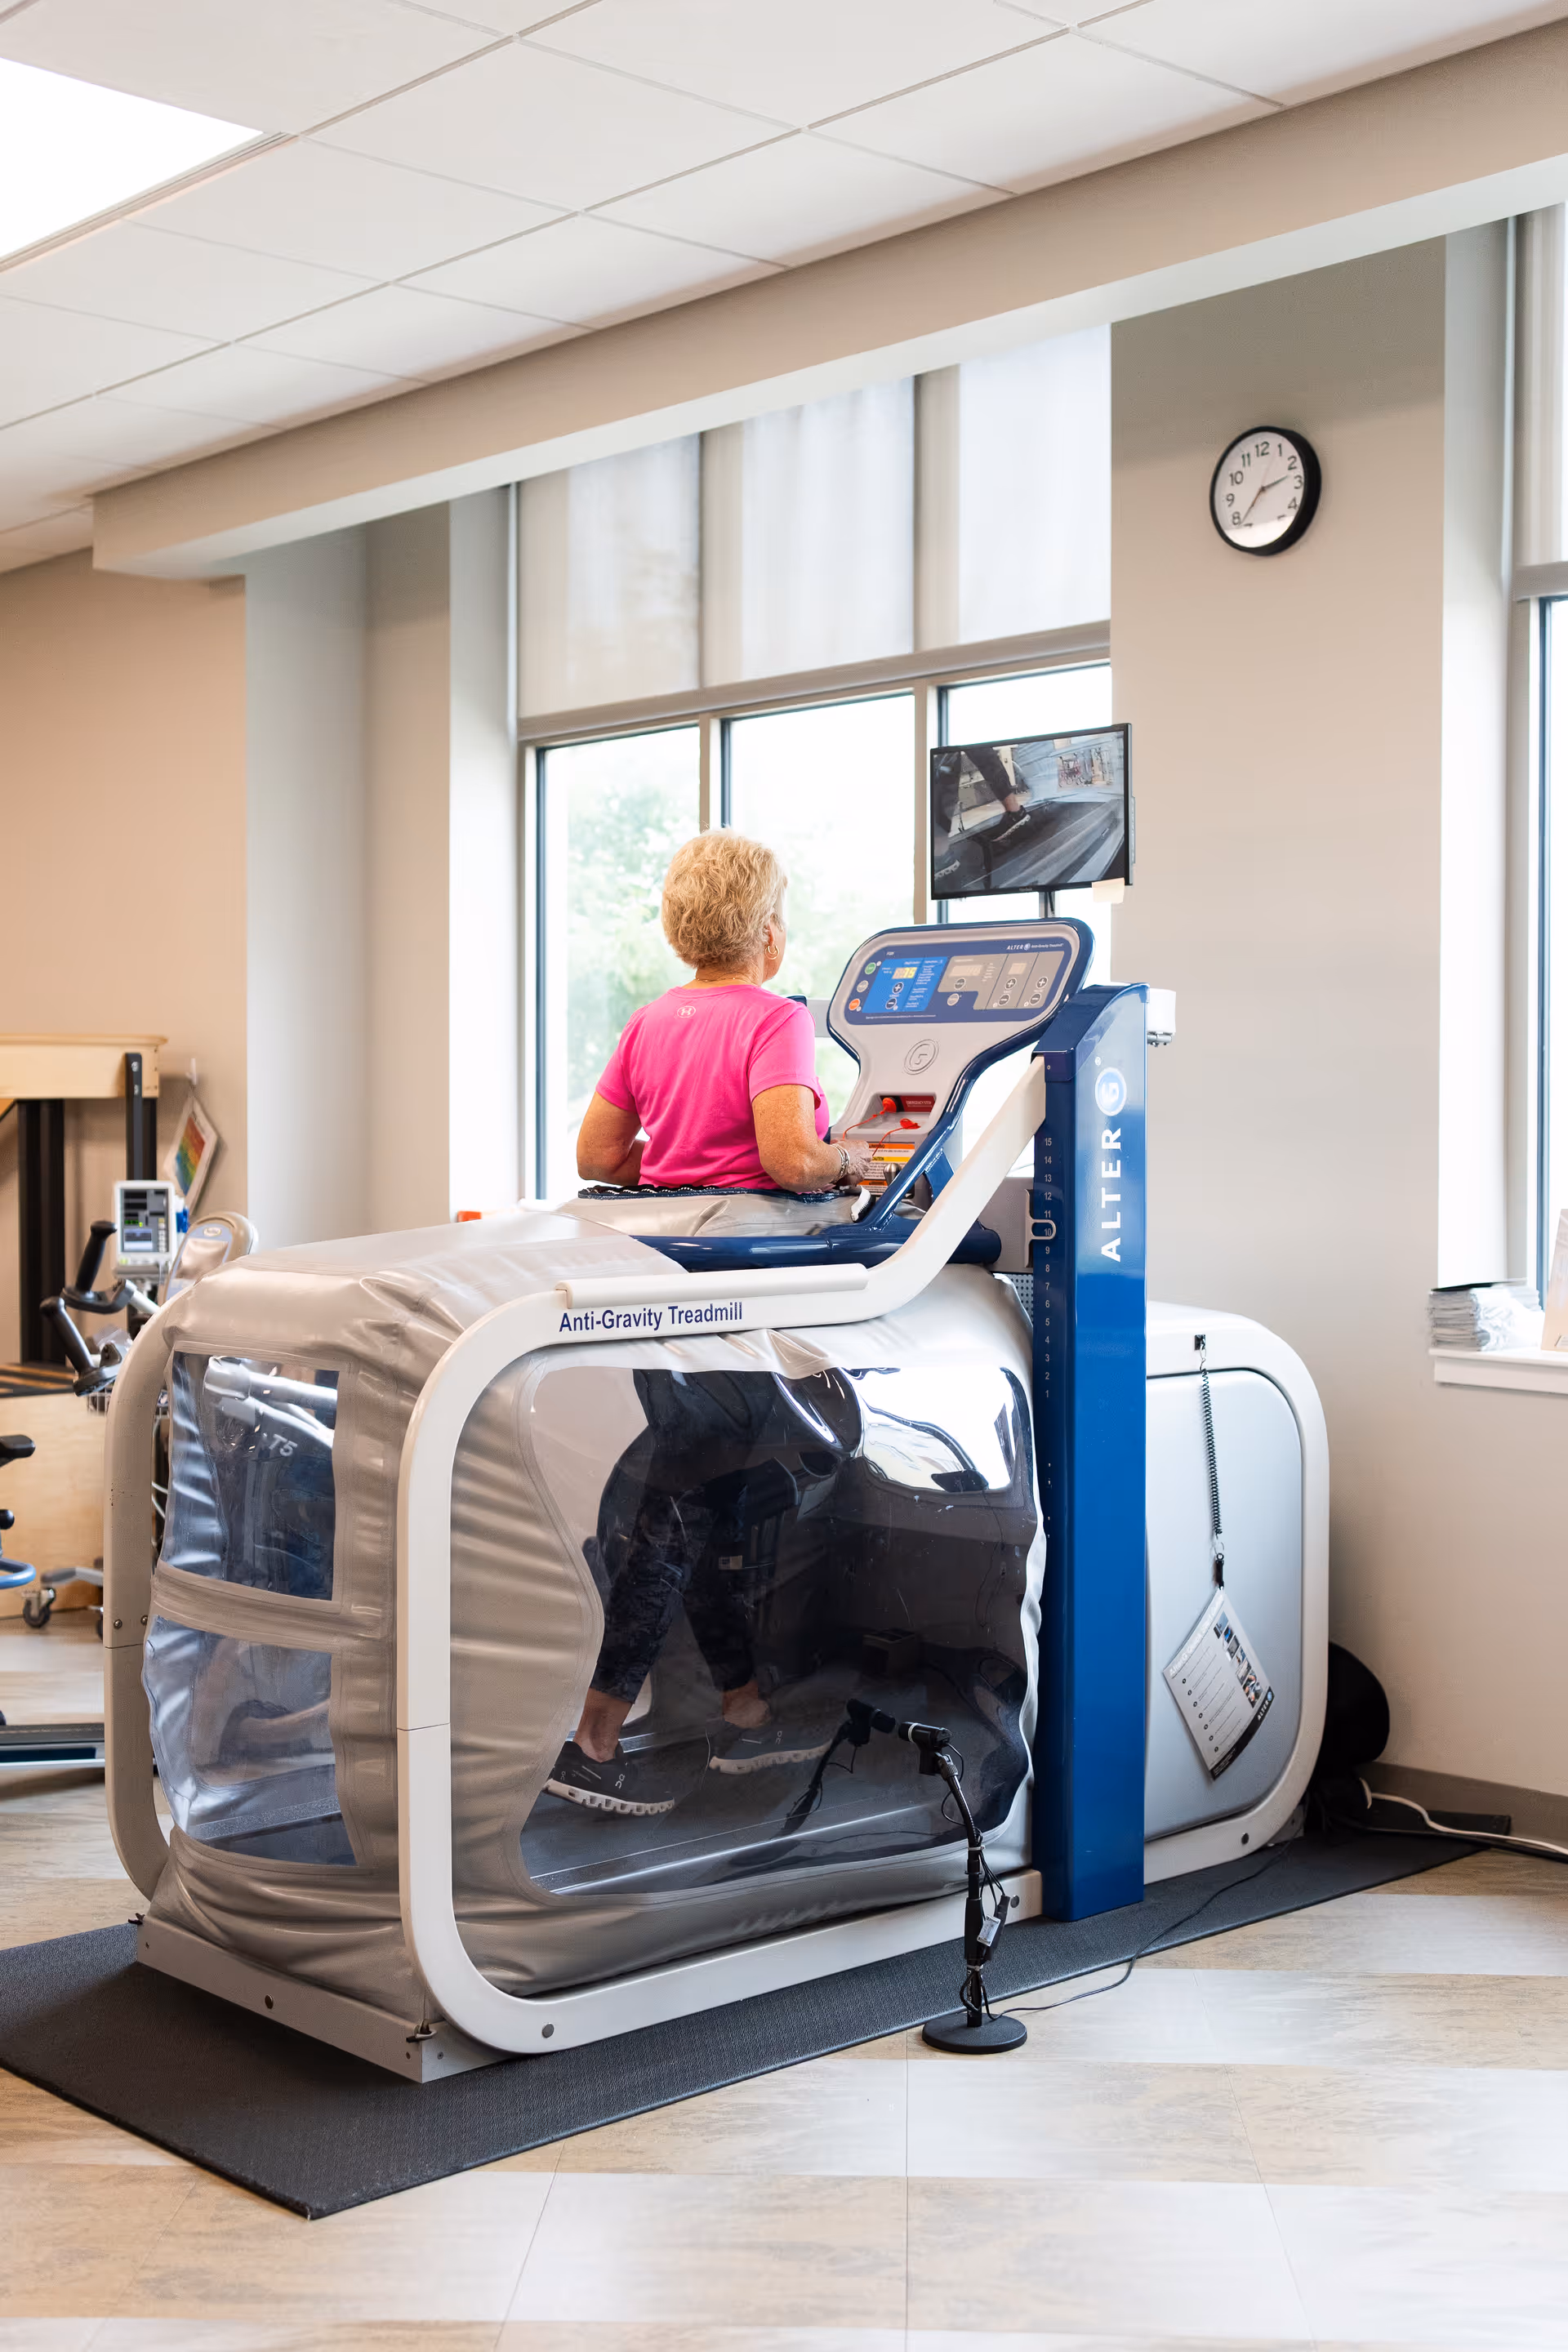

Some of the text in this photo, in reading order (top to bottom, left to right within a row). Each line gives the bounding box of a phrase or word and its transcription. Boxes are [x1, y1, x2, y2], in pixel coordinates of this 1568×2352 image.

[1254, 441, 1270, 457] 12
[1277, 443, 1282, 457] 1
[1241, 453, 1251, 467] 11
[1287, 456, 1297, 471] 2
[1229, 470, 1244, 486] 10
[1294, 474, 1303, 490] 3
[1226, 493, 1235, 507] 9
[1288, 497, 1298, 510] 4
[1232, 511, 1241, 526] 8
[1045, 1138, 1052, 1147] 15
[1045, 1174, 1052, 1183] 13
[1102, 1128, 1121, 1262] ALTER
[1045, 1246, 1049, 1254] 9
[1045, 1264, 1049, 1272] 8
[559, 1302, 742, 1331] Anti-Gravity Treadmill
